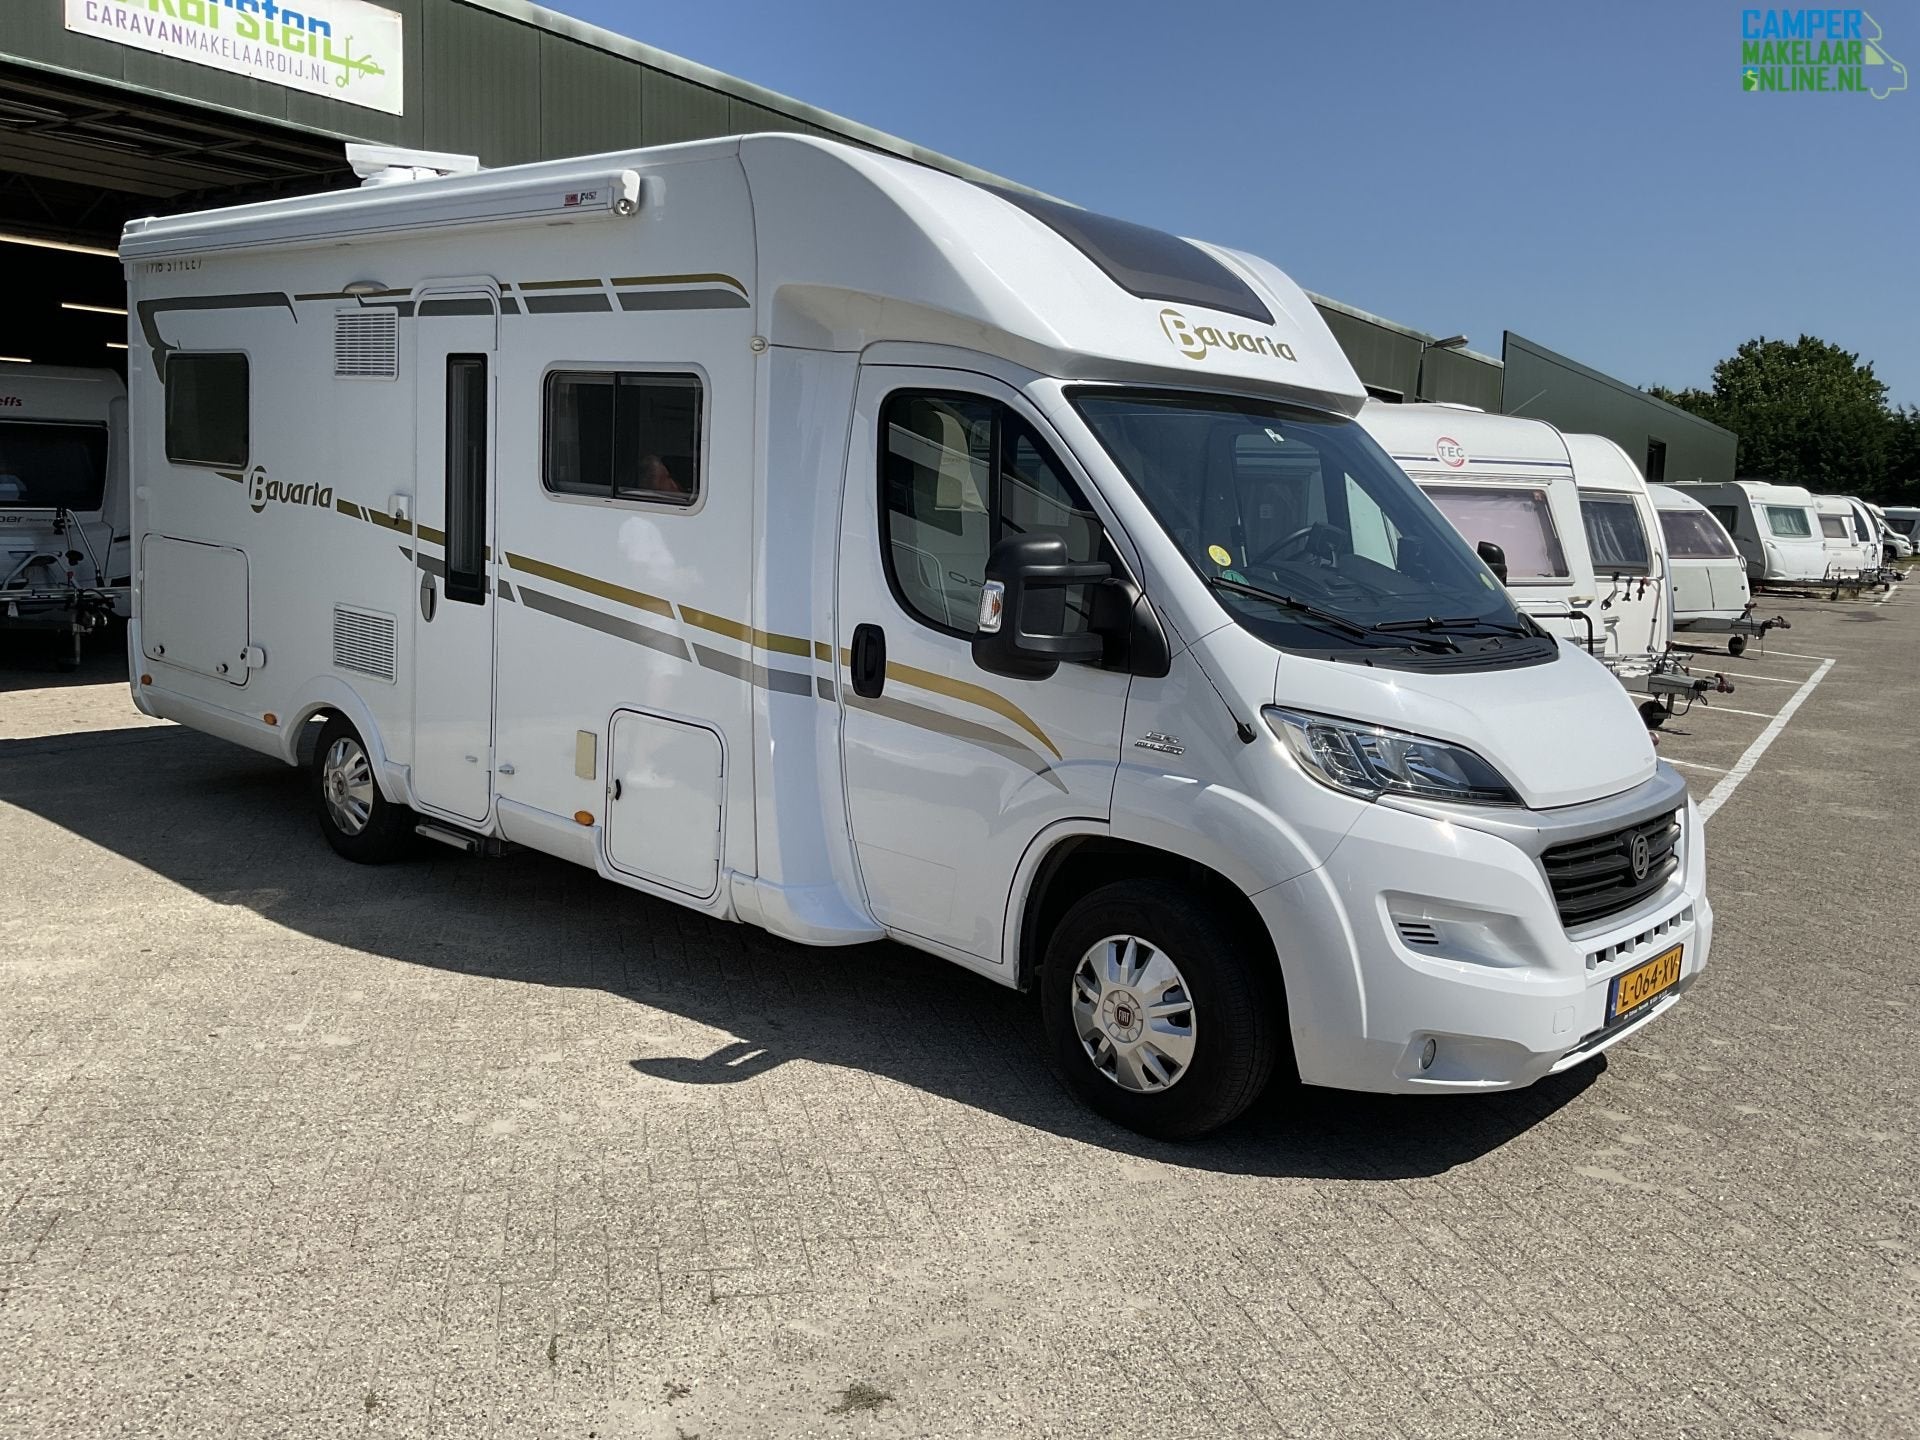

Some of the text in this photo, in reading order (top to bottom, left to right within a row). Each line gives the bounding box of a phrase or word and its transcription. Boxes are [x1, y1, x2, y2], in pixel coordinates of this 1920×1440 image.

[86, 1, 329, 85] CARAVANMAKELAARDIJ.NL
[1159, 308, 1297, 362] Bavaria
[1438, 446, 1465, 458] TEC
[249, 465, 333, 513] Bavaria
[1620, 953, 1678, 1007] L-064-XV
